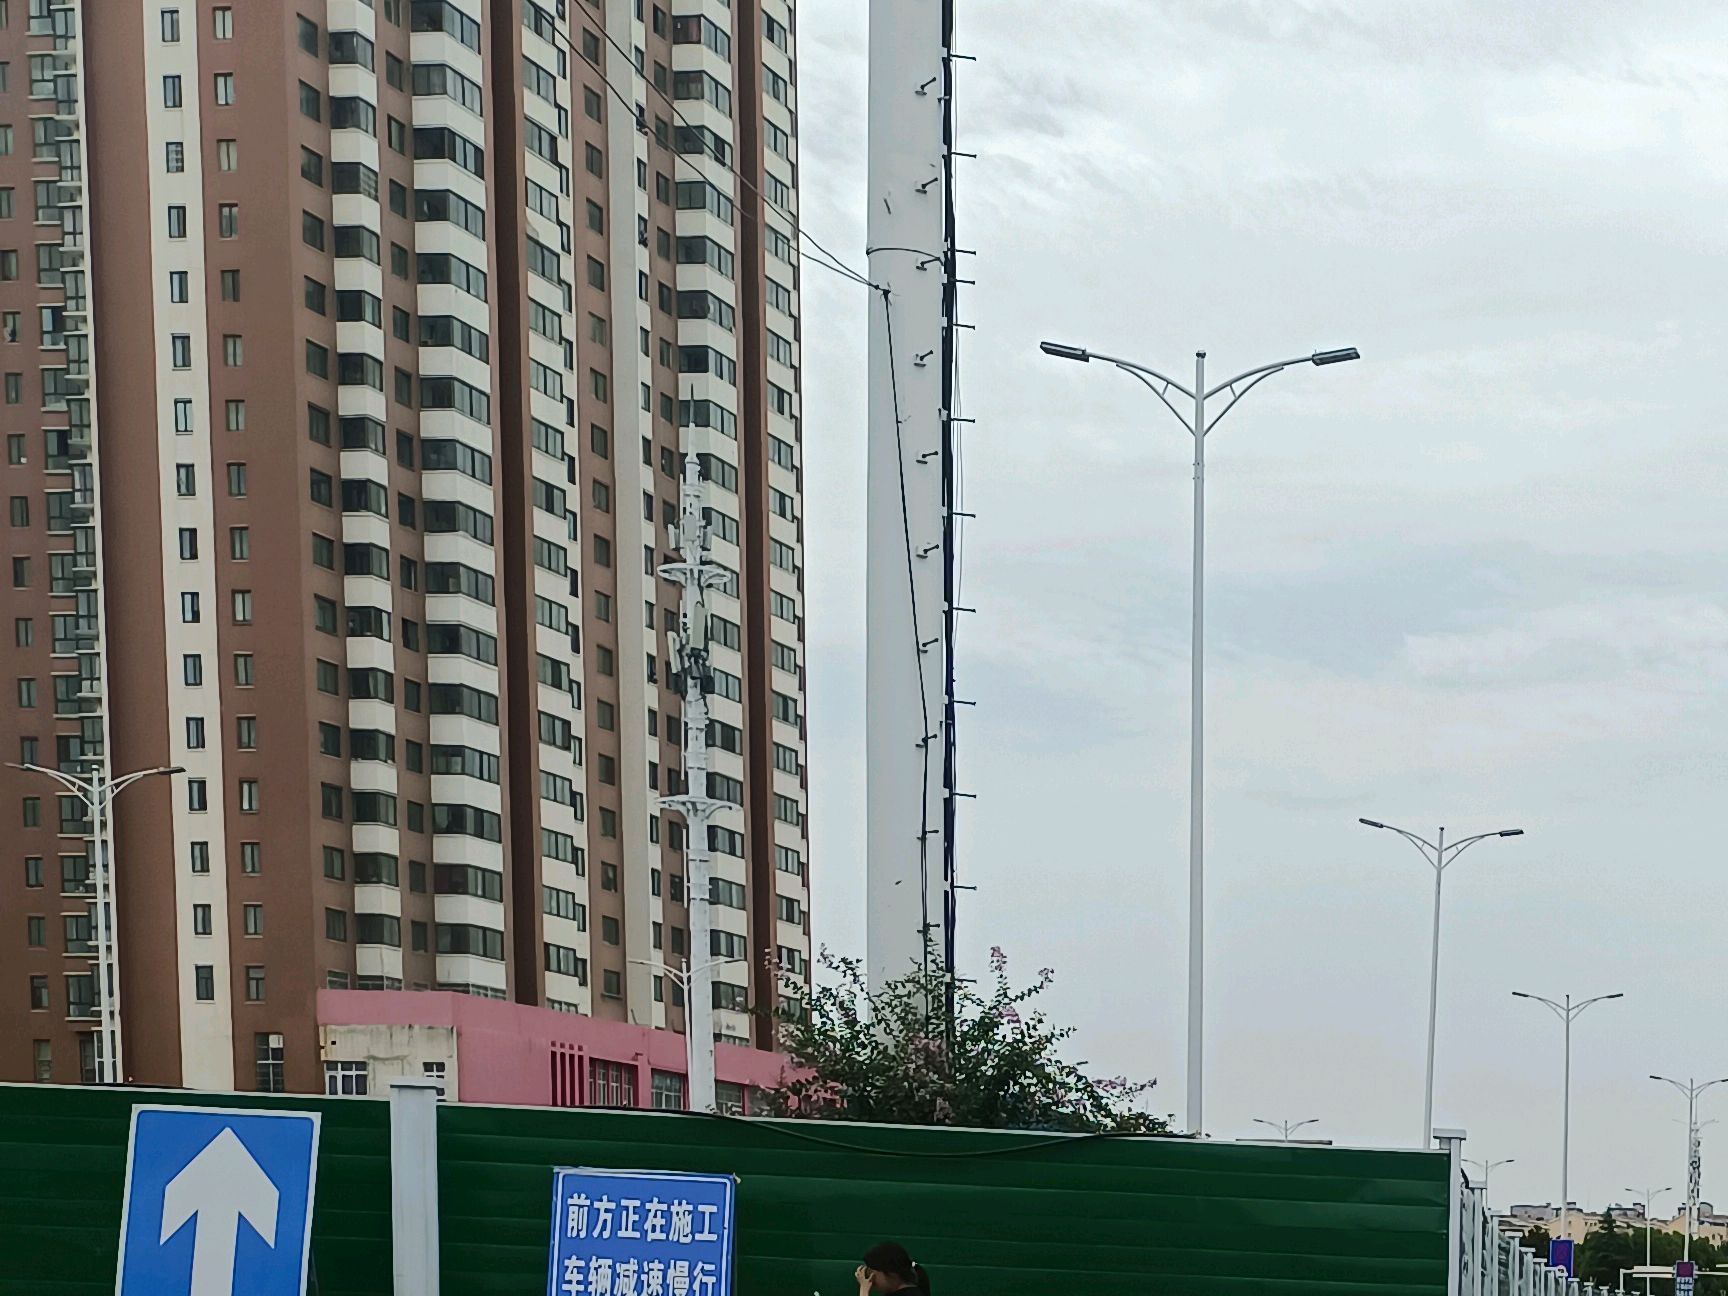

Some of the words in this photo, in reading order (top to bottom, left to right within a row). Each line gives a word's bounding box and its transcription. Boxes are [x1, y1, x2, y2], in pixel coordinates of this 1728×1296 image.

[567, 1193, 718, 1244] 前方正在施工
